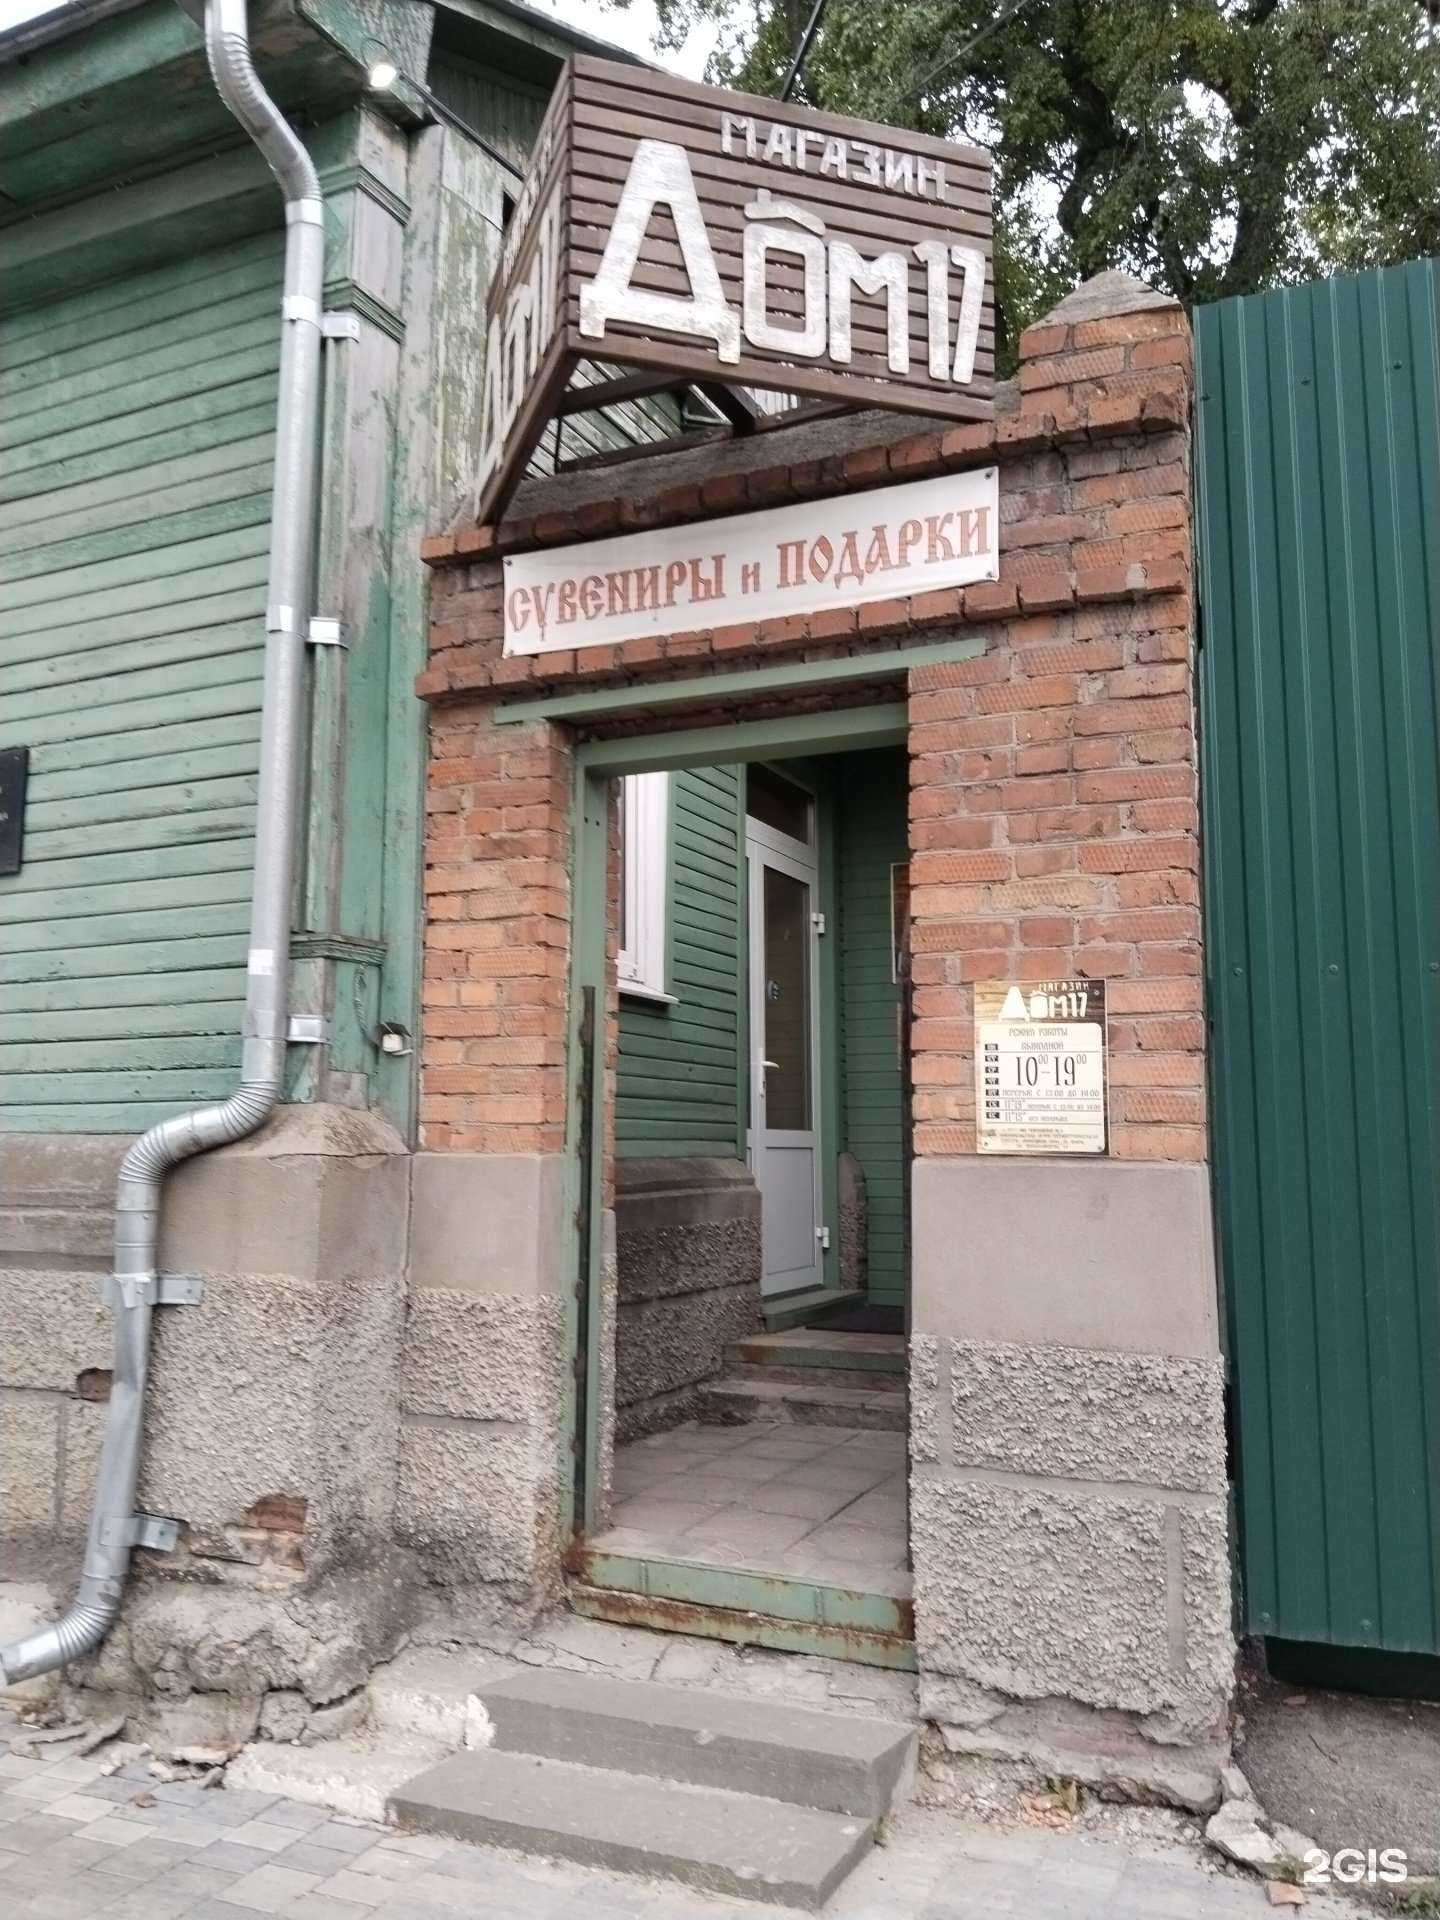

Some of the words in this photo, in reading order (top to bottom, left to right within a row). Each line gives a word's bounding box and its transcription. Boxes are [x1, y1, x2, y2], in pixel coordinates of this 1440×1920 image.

[719, 110, 947, 201] МАГАЗИН
[578, 137, 987, 386] ДОМ17
[507, 553, 727, 642] СУВЕНИРЫ
[775, 505, 993, 590] ПОДАРКИ
